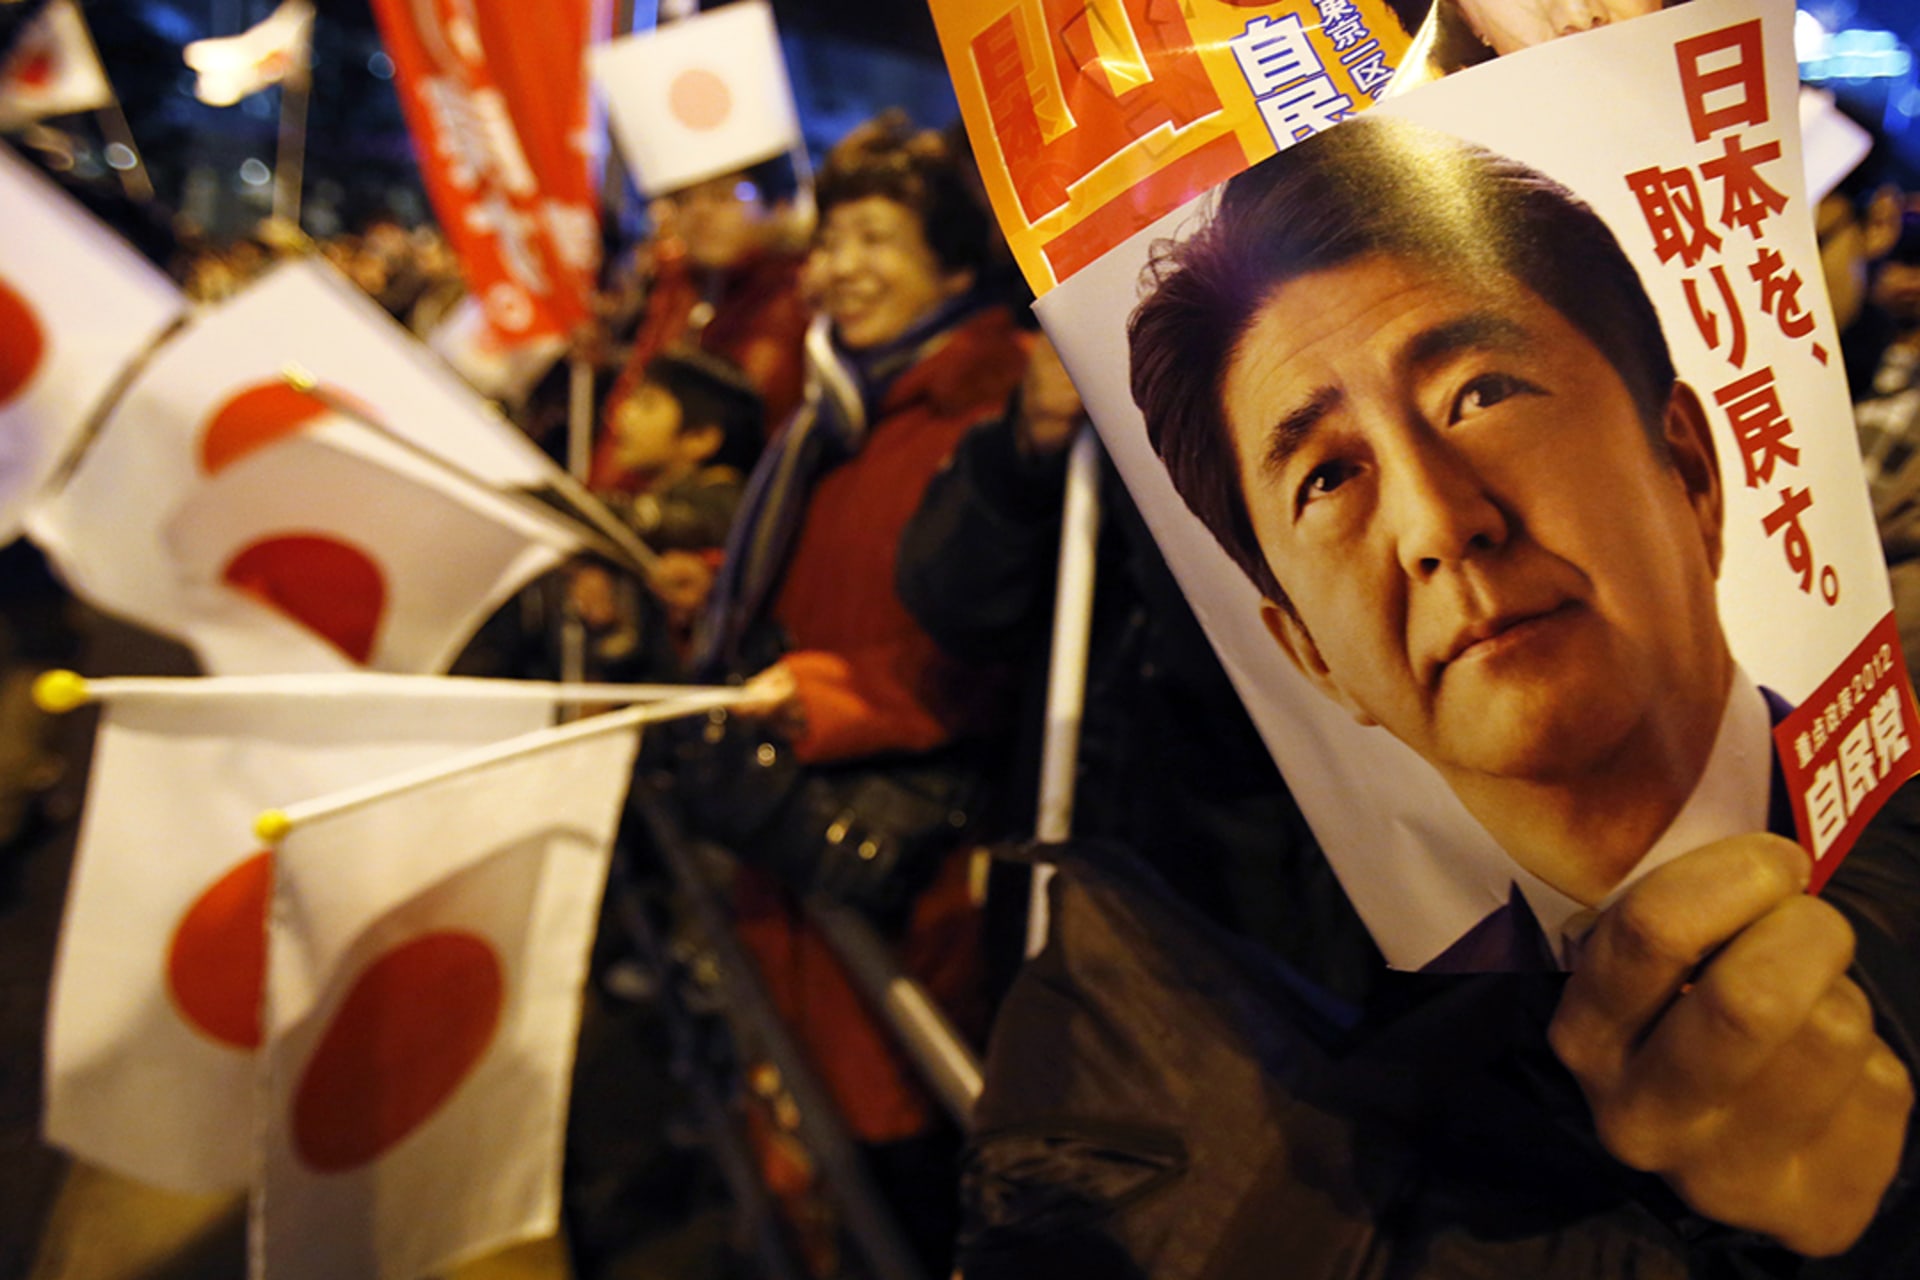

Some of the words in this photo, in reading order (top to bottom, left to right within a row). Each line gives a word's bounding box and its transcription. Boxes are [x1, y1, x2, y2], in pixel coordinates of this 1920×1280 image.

[1675, 18, 1828, 367] 日本を、
[1624, 166, 1838, 606] 取り戻す。
[1794, 643, 1894, 769] 重点政策2012
[1804, 684, 1911, 862] 自民党
